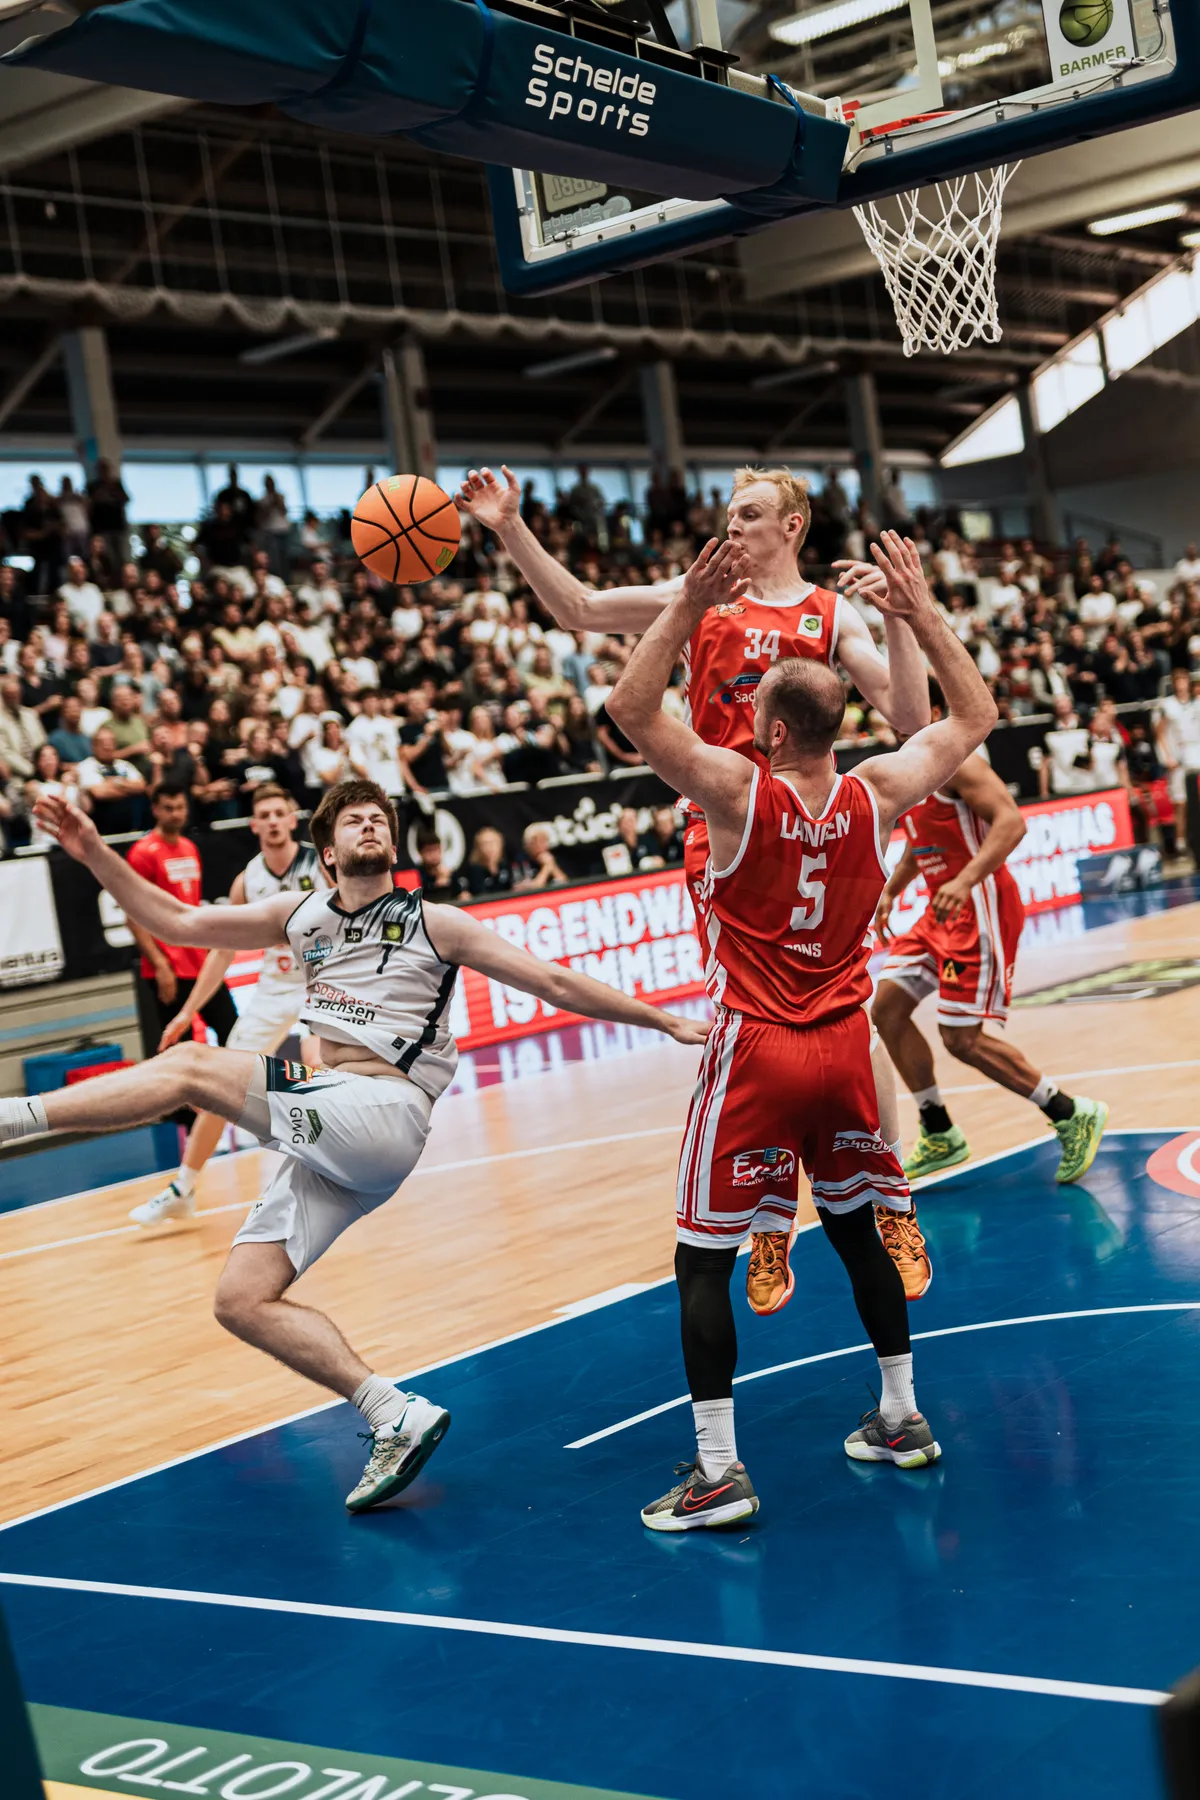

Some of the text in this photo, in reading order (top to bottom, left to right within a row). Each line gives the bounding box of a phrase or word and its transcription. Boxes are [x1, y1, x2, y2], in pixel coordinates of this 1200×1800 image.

[531, 43, 657, 105] Schelde
[1059, 45, 1127, 77] BARMER
[525, 78, 650, 137] Sports
[744, 627, 781, 662] 34
[789, 852, 827, 931] 5
[784, 942, 822, 958] ONS
[314, 982, 383, 1009] Sparka
[314, 1000, 376, 1021] Sachsen
[80, 1738, 530, 1800] NLOTTO
